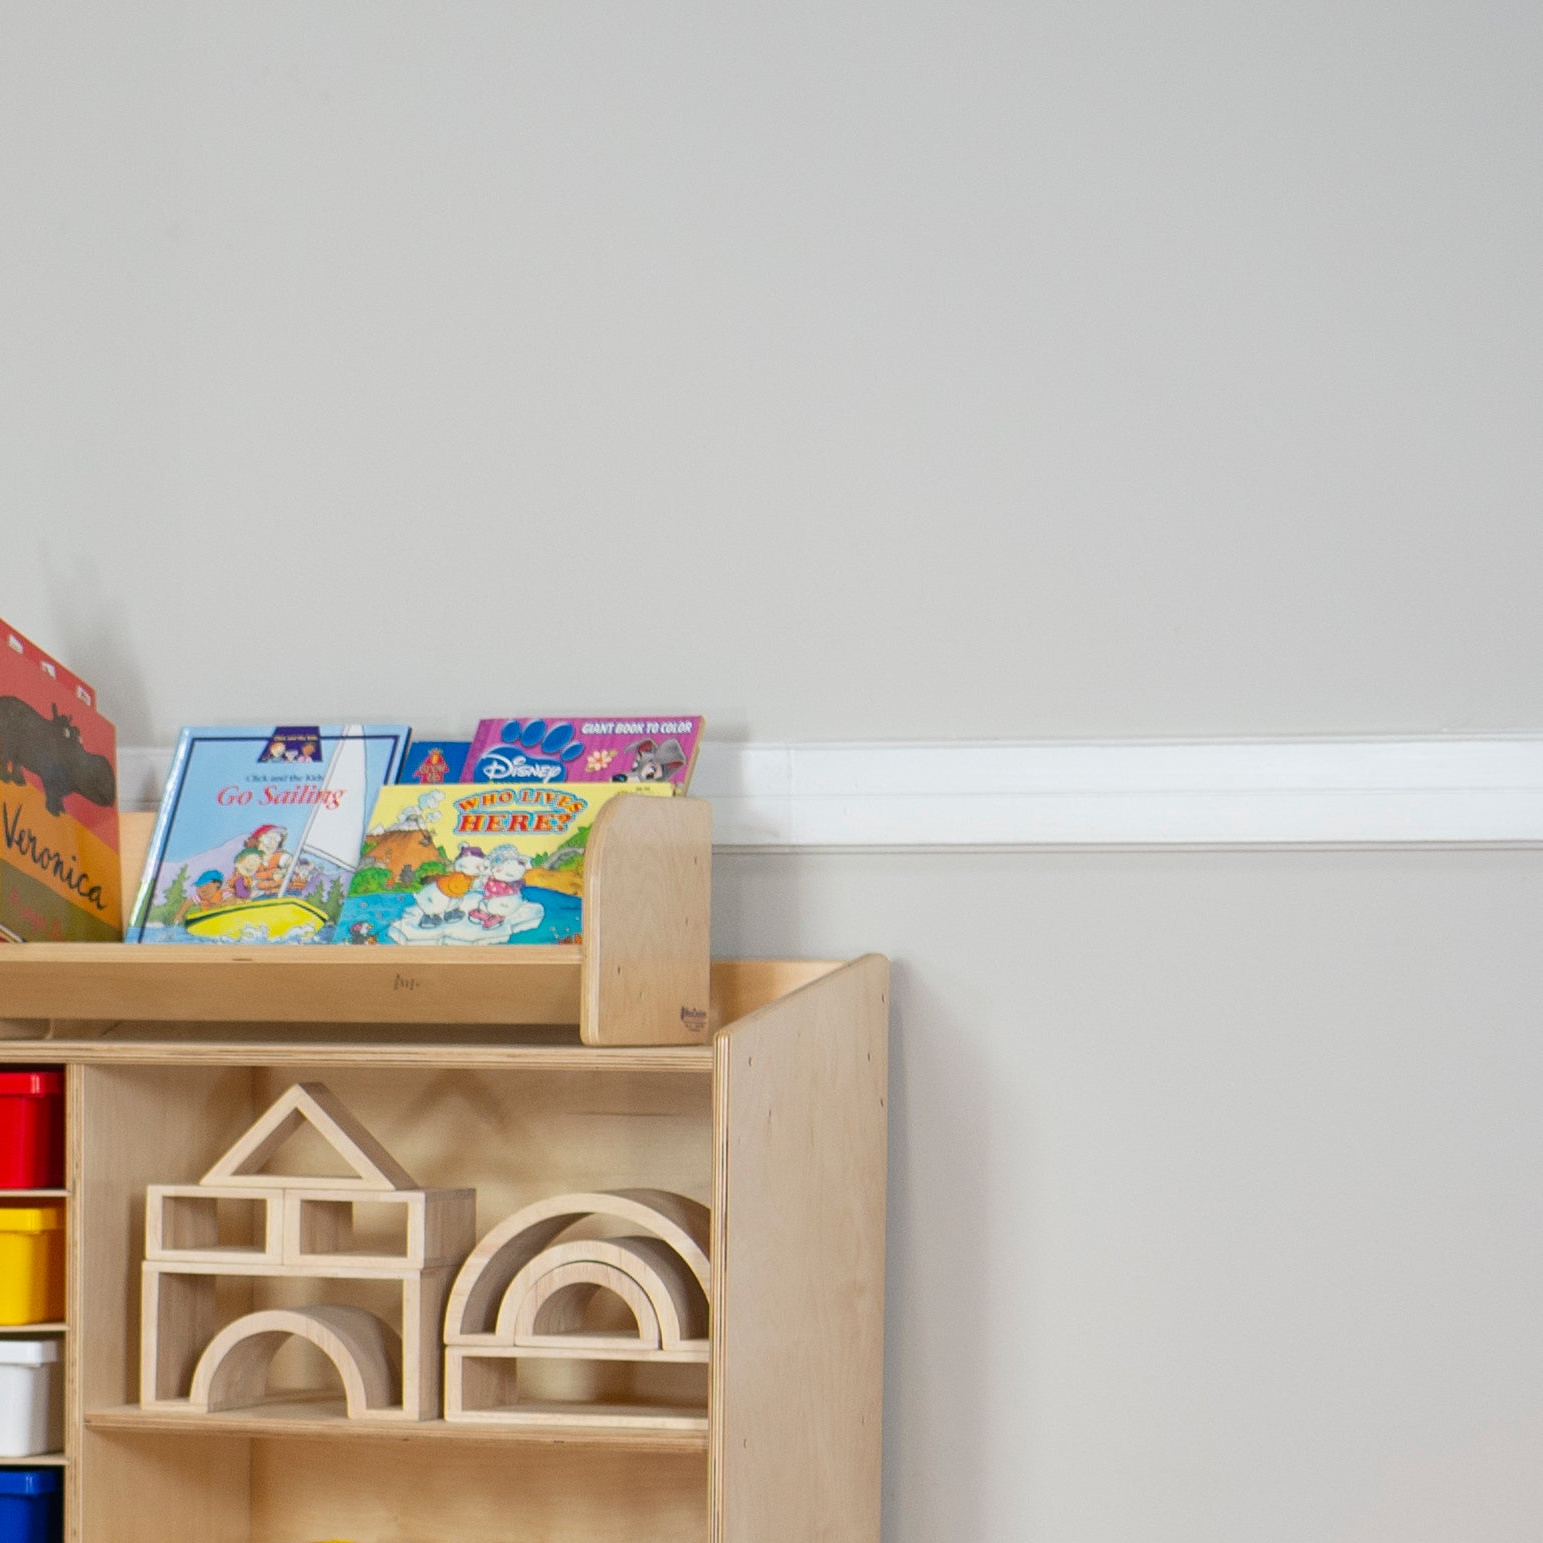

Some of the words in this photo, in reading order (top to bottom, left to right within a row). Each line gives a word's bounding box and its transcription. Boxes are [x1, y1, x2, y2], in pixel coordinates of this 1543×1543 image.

[581, 722, 614, 734] GIANT
[615, 722, 645, 734] BOOK
[646, 722, 659, 734] TO
[660, 720, 693, 733] COLOR
[245, 773, 268, 783] Click
[270, 773, 287, 783] and
[289, 773, 304, 783] the
[306, 773, 324, 783] Kids
[217, 784, 253, 806] Go
[258, 784, 346, 810] Sailing
[457, 790, 513, 811] WHO
[520, 790, 584, 813] LIVES
[458, 813, 572, 832] HERE?
[3, 803, 106, 911] Veronica
